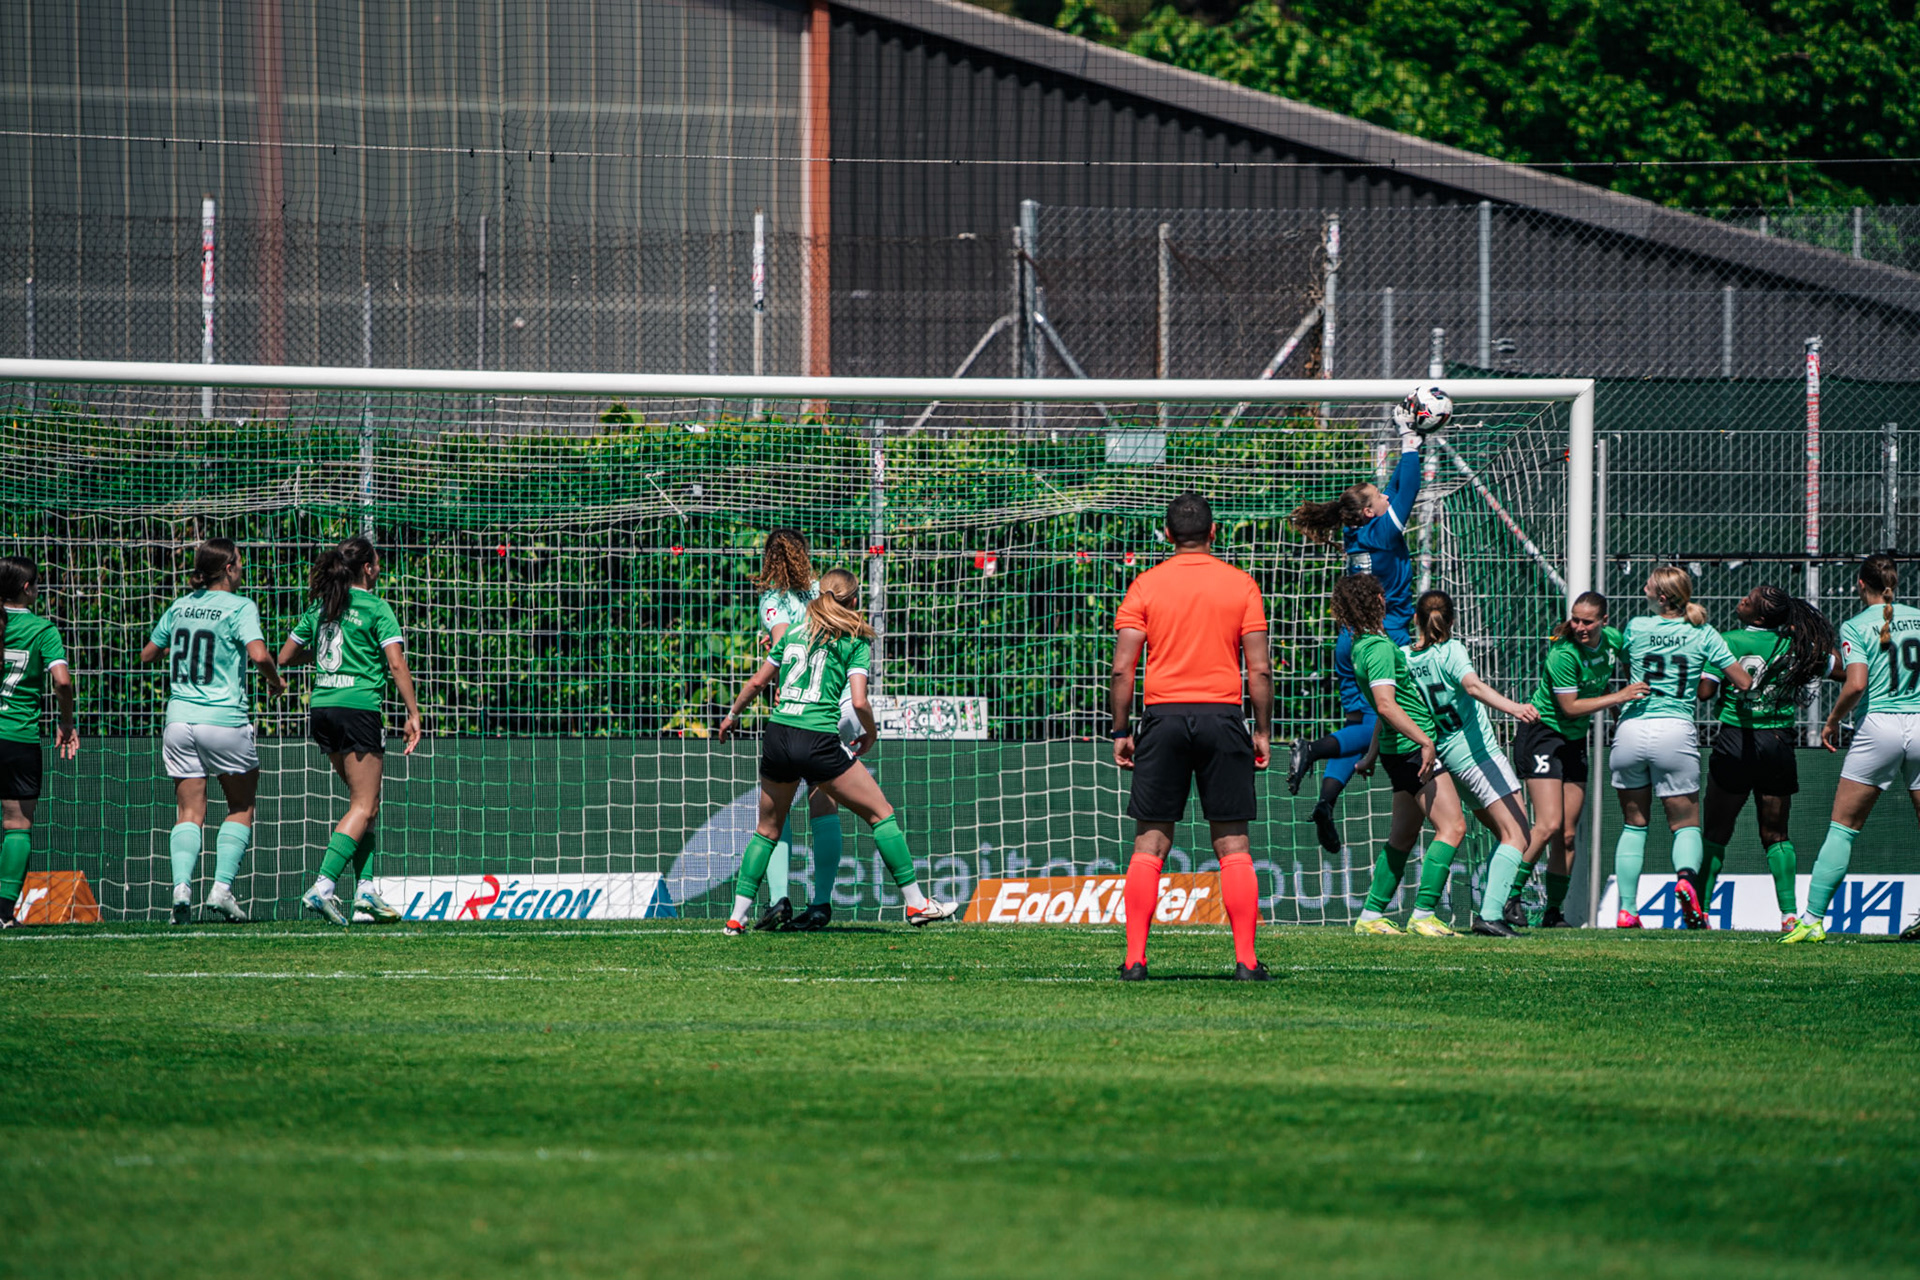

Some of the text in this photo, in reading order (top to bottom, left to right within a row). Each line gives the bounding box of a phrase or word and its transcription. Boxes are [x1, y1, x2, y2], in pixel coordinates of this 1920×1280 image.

[172, 627, 216, 685] 20
[317, 621, 343, 673] 8
[1650, 635, 1687, 647] ROCHAT
[779, 643, 828, 703] 21
[1642, 653, 1689, 699] 21
[1882, 637, 1920, 697] 19
[400, 874, 602, 921] LA RÉGION
[987, 877, 1210, 924] EgoKier
[1638, 881, 1735, 931] AA
